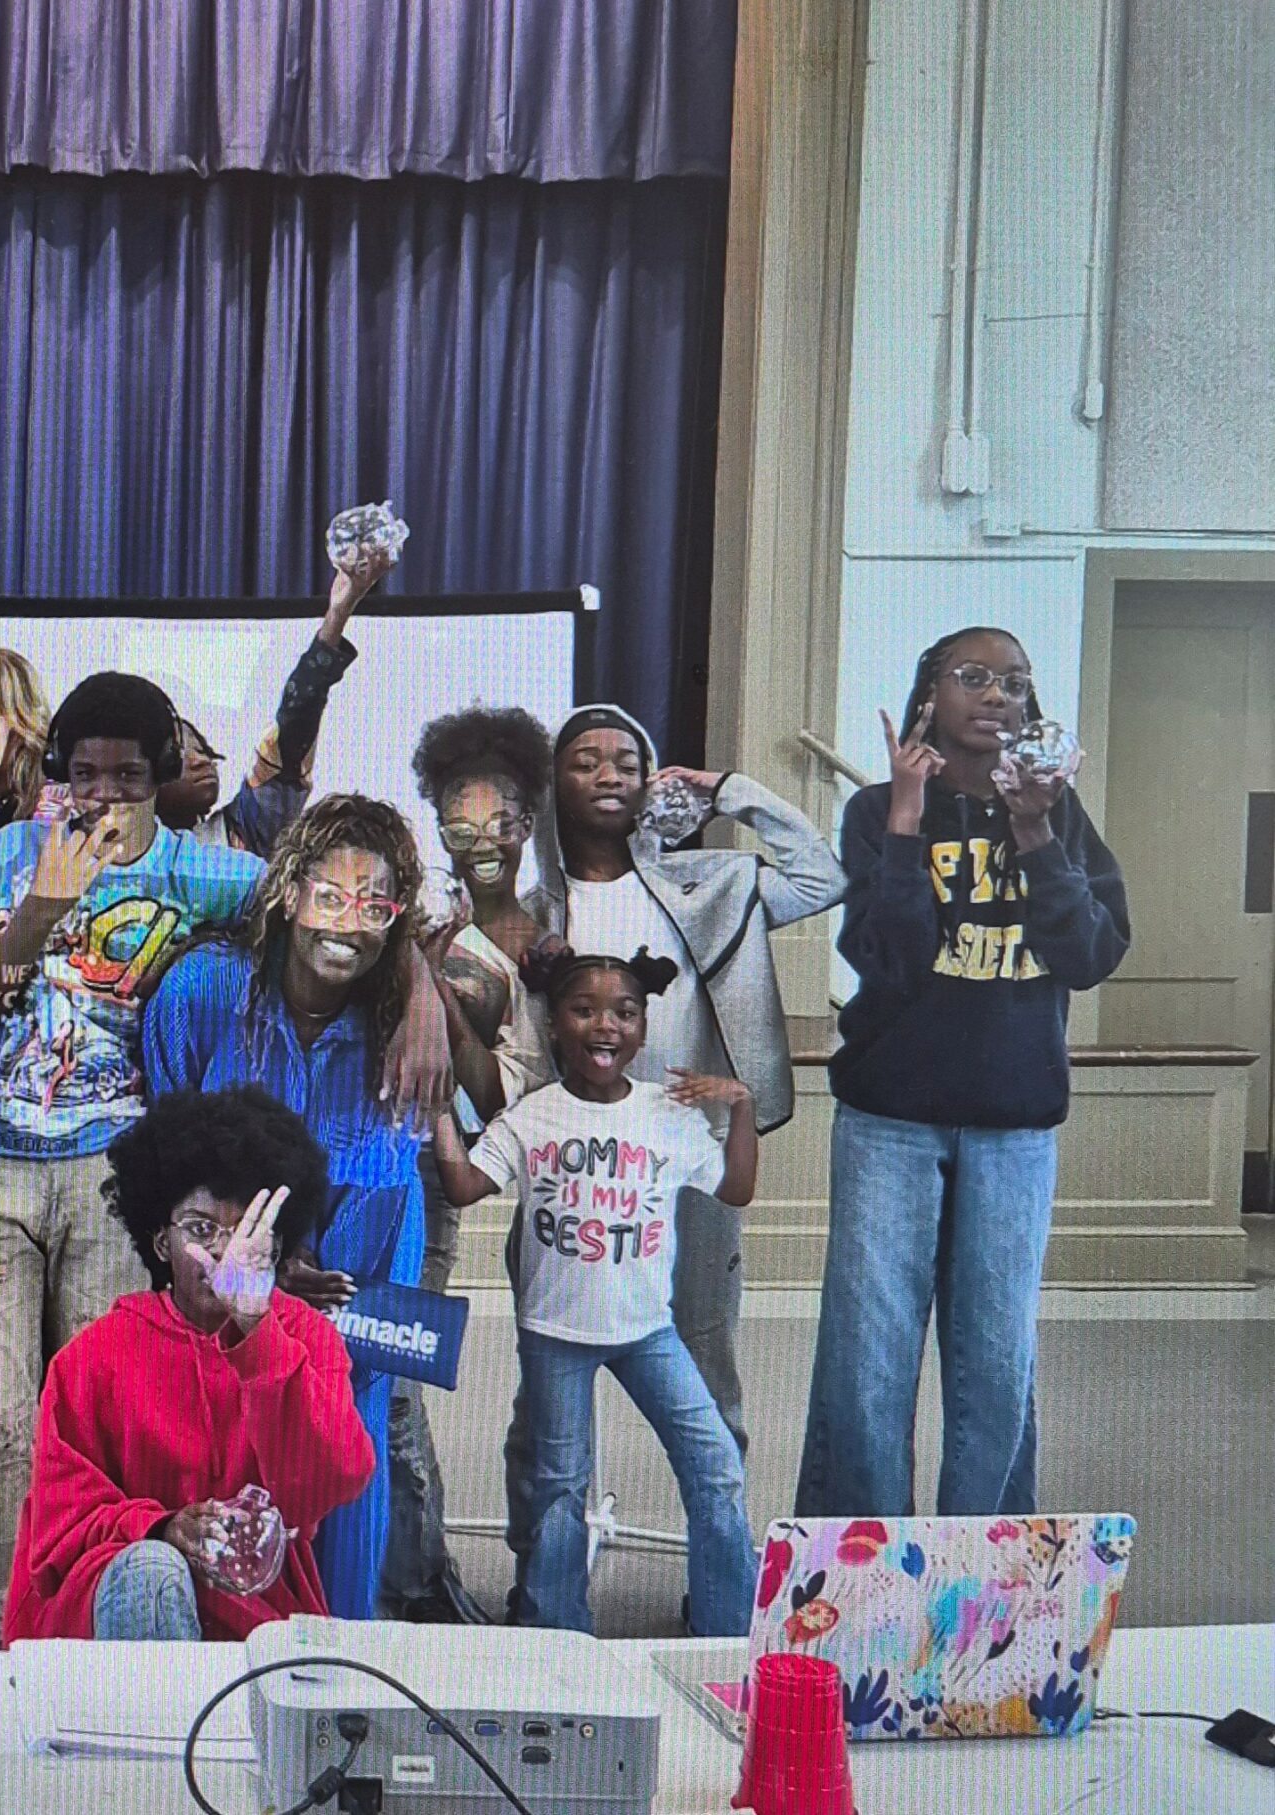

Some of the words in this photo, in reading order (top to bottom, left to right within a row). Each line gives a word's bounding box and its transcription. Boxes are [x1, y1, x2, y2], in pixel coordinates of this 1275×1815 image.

[528, 1136, 670, 1184] MOMMY
[561, 1178, 580, 1208] is
[591, 1181, 638, 1220] my
[533, 1207, 665, 1265] BESTIE
